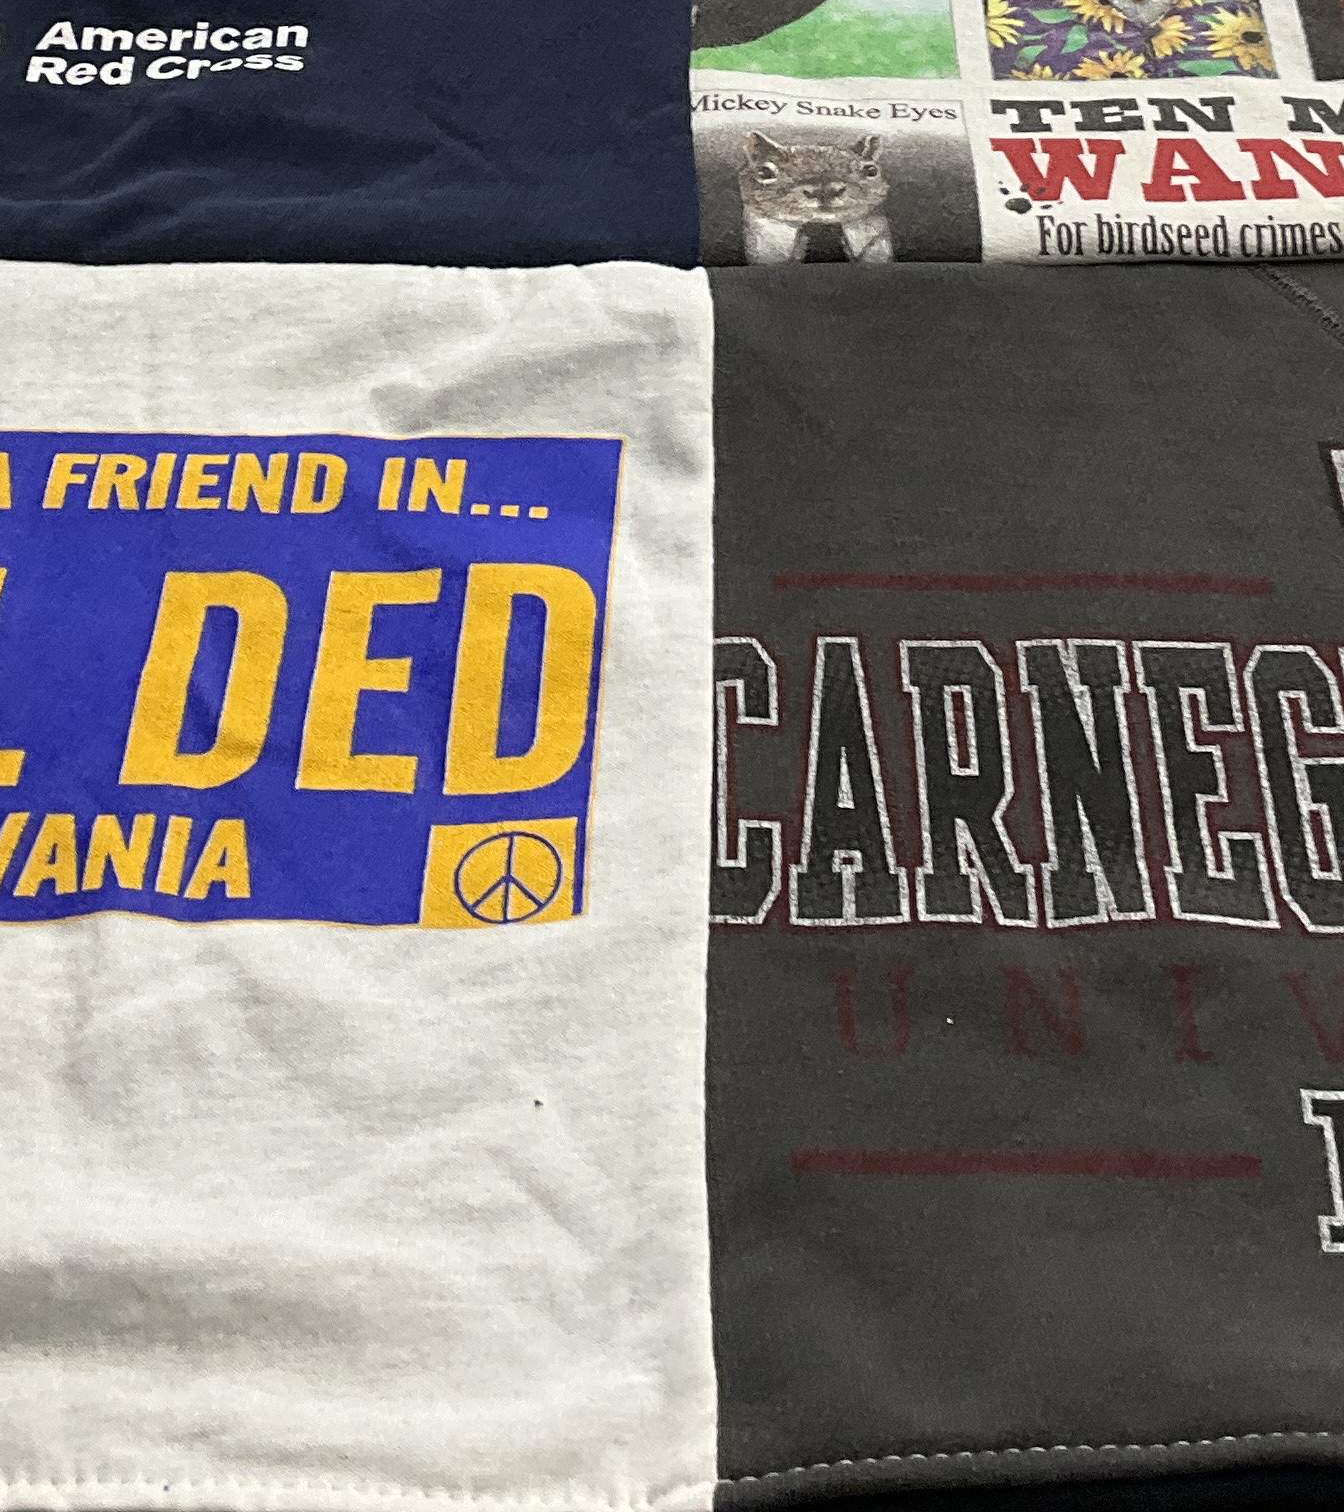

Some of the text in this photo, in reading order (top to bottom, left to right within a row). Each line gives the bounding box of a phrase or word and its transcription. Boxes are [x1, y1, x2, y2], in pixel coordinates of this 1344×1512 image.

[35, 20, 311, 52] American
[24, 52, 305, 87] Red Cross
[690, 93, 959, 122] Mickey Snake Eyes
[989, 95, 1237, 133] TEN
[1036, 214, 1085, 257] For
[1094, 213, 1232, 259] birdseed
[43, 451, 349, 516] FRIEND
[378, 456, 551, 522] IN...
[117, 560, 599, 798] DED
